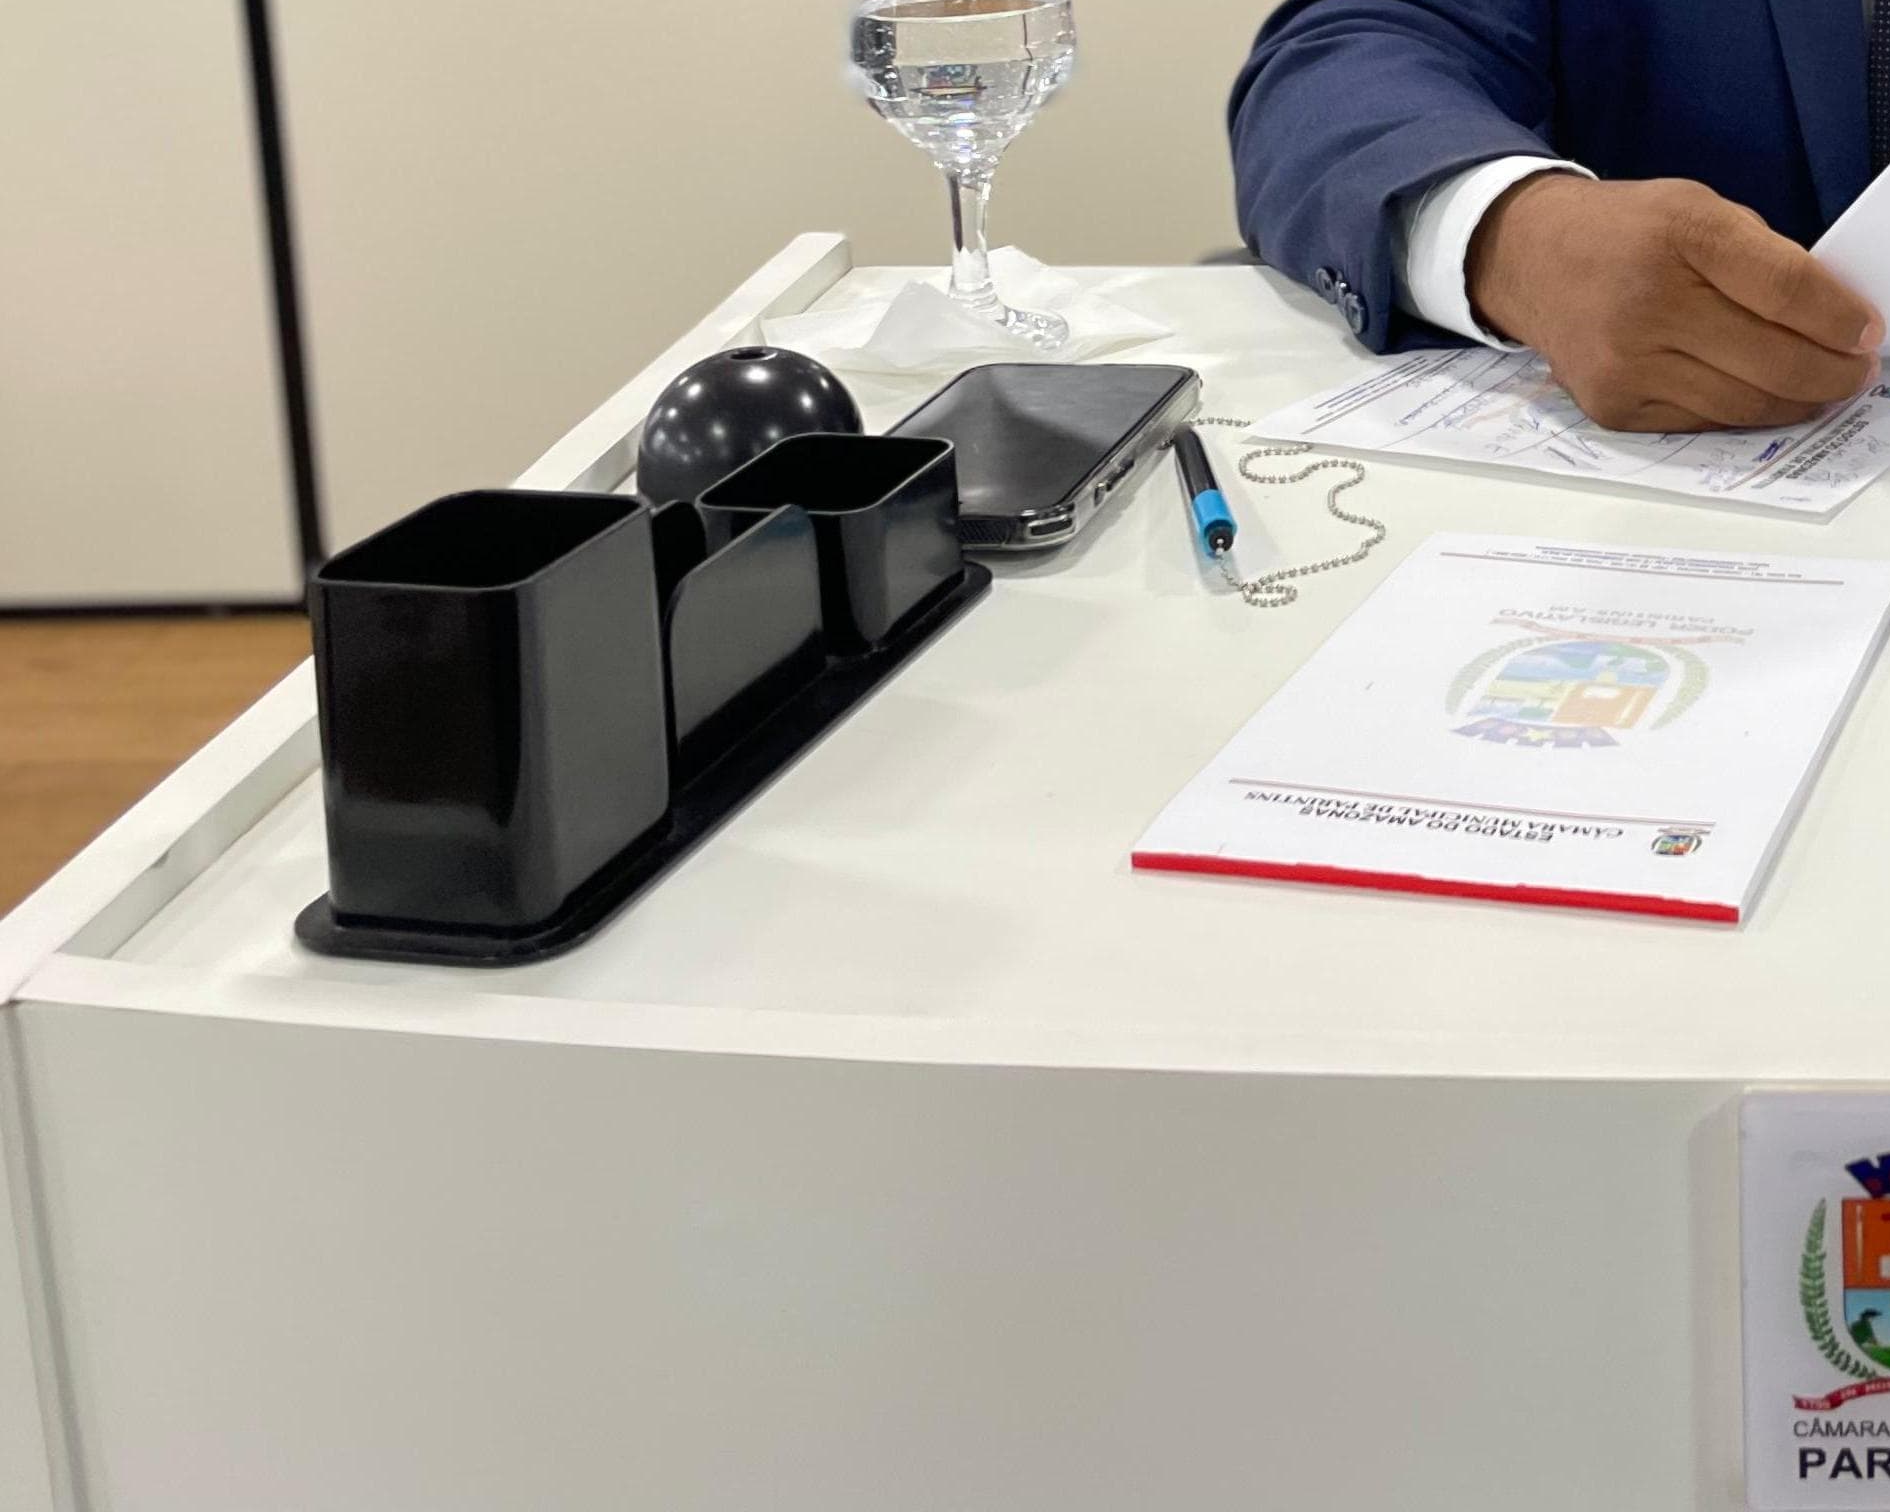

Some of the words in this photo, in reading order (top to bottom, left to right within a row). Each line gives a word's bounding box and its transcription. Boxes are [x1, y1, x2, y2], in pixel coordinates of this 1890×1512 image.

[1499, 608, 1656, 629] LEGISLATIVO
[1669, 622, 1754, 636] PODER
[1244, 791, 1361, 810] PARINTINS
[1365, 803, 1394, 814] DE
[1299, 806, 1424, 827] AMAZONAS
[1398, 806, 1521, 829] MUNICIPAL
[1426, 818, 1460, 833] DO
[1464, 823, 1554, 842] ESTADO
[1793, 1417, 1890, 1438] CÂMARA
